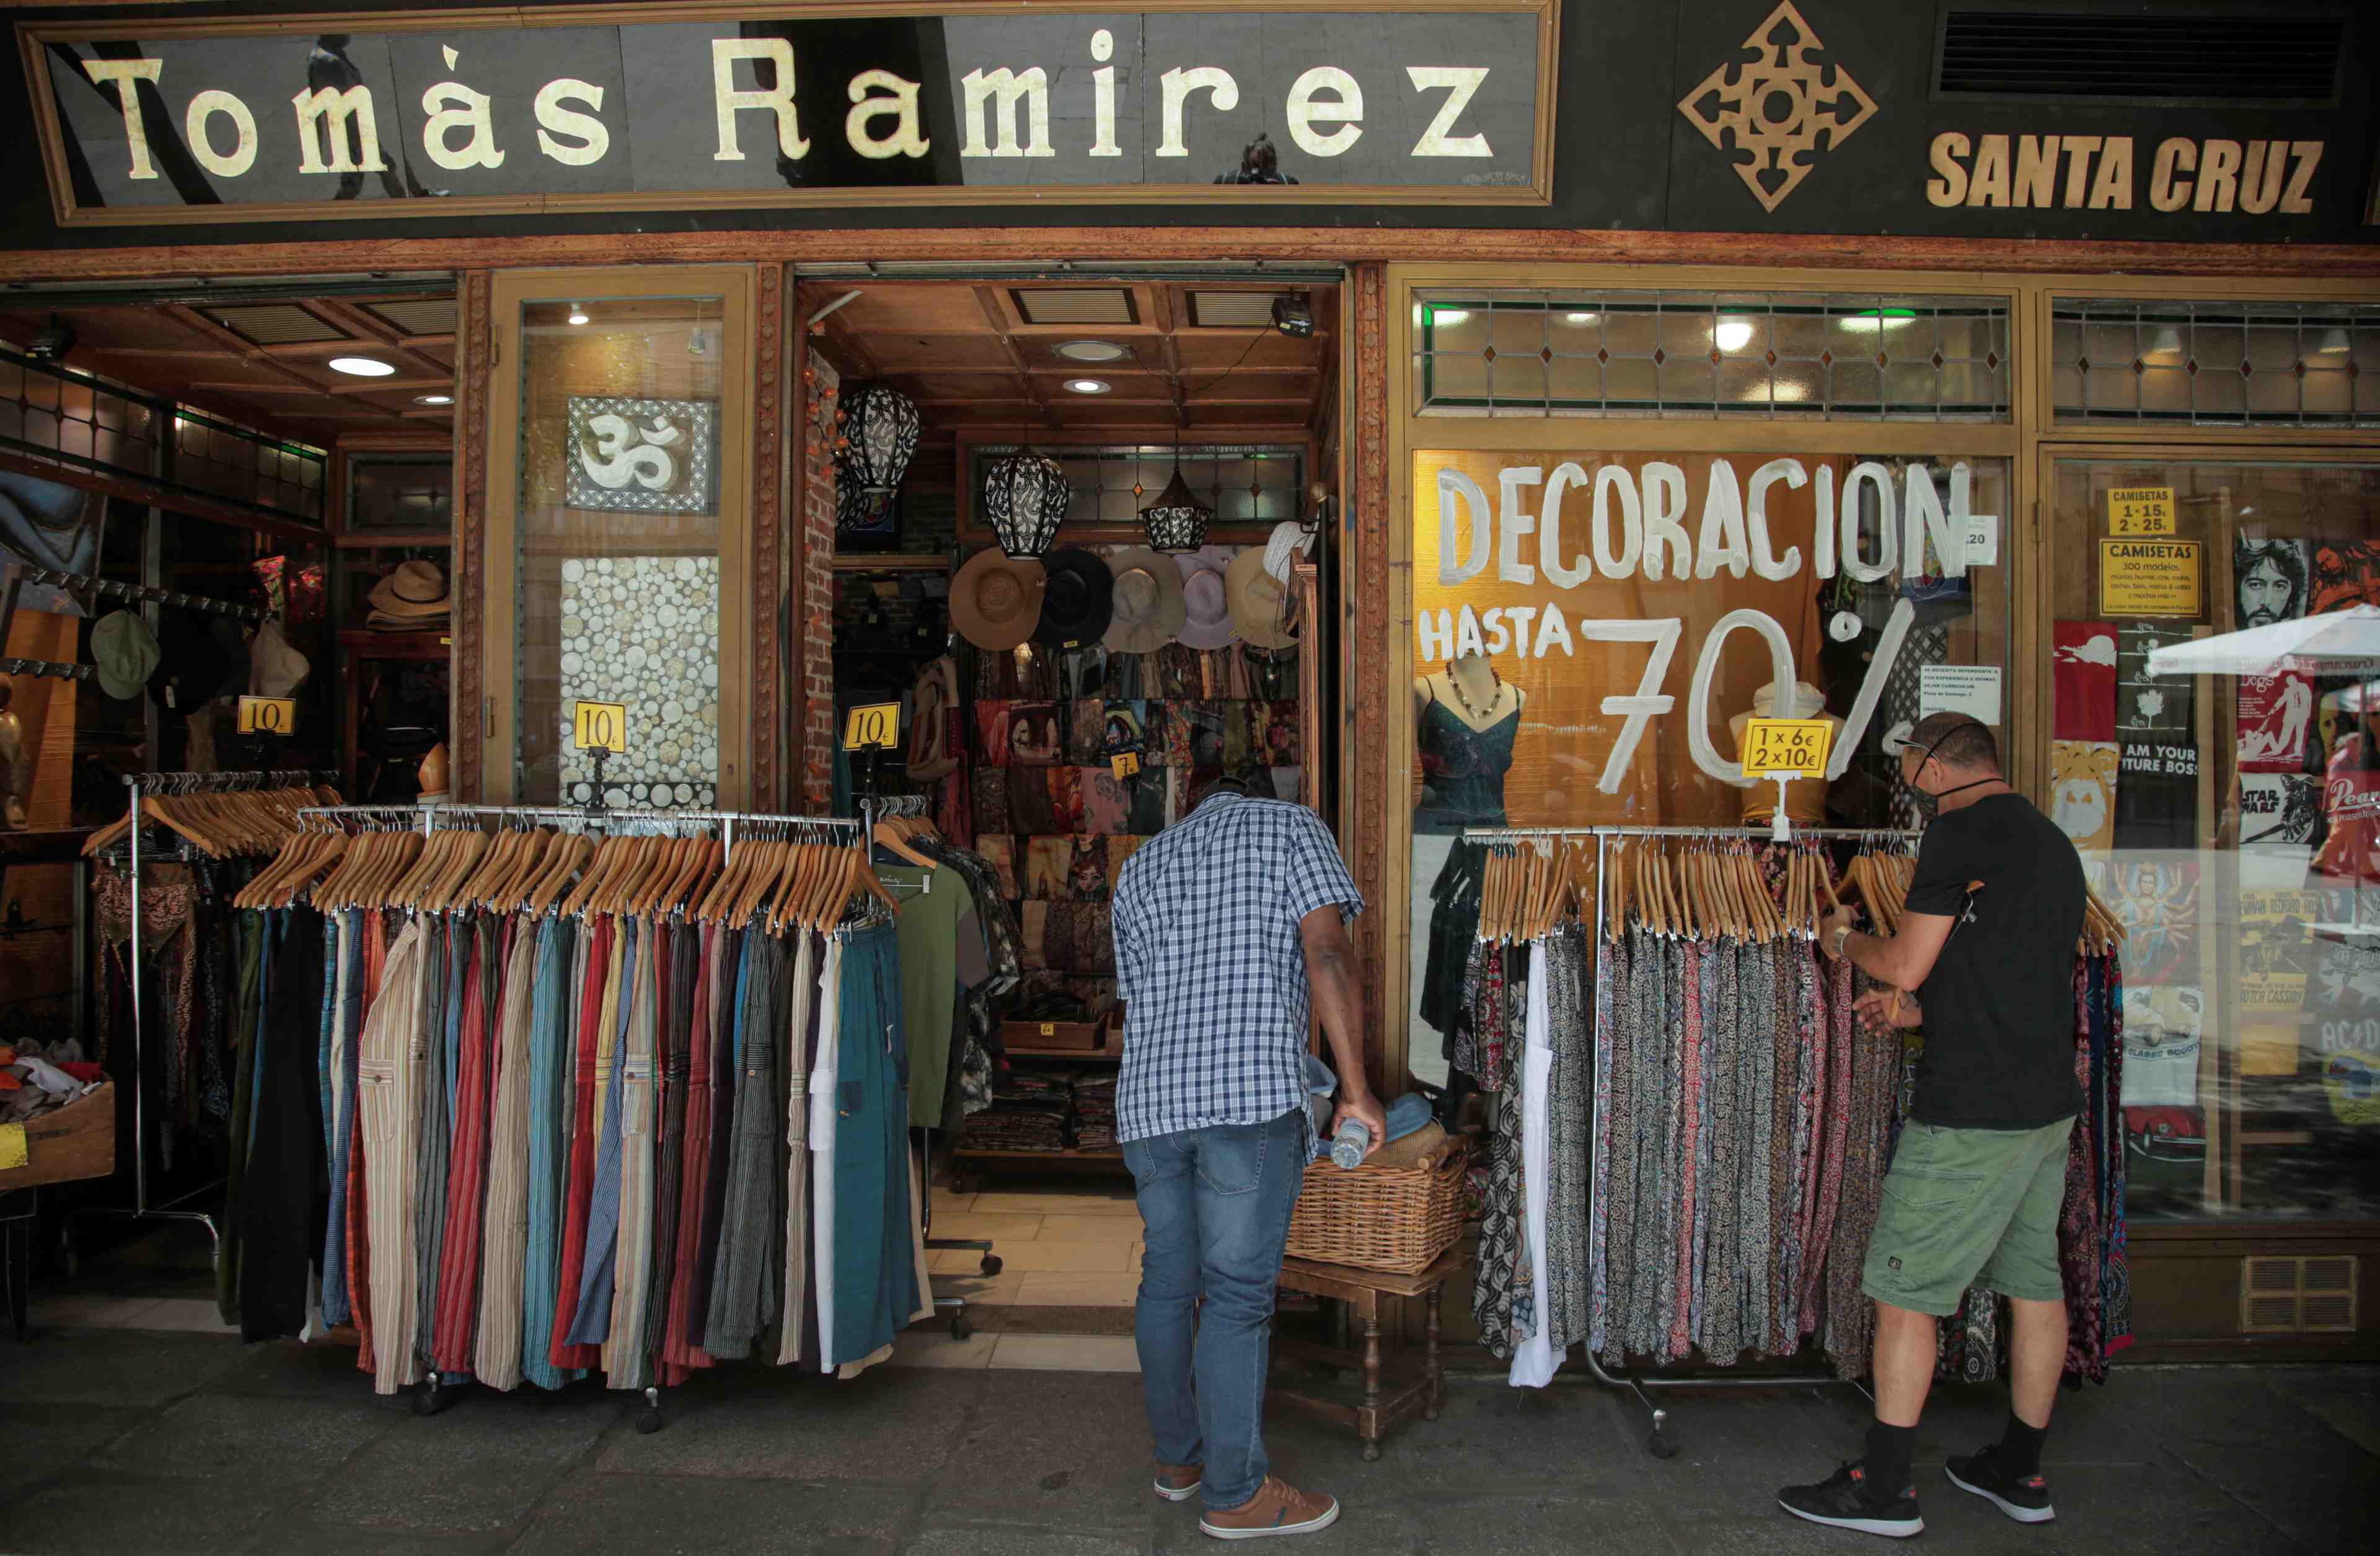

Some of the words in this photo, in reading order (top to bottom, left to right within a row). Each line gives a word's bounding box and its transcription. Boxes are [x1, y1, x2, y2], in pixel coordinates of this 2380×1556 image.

[711, 29, 1494, 161] Ramirez
[1926, 131, 2133, 210] SANTA
[2149, 137, 2324, 214] CRUZ
[2113, 490, 2168, 501] CAMISETAS
[2123, 505, 2133, 517] 1
[1437, 458, 1970, 589] DECORACION
[2120, 519, 2128, 531] 2
[2110, 545, 2192, 559] CAMISETAS
[2122, 562, 2141, 570] 300
[2241, 674, 2275, 693] Dogs
[1418, 603, 1574, 662] HASTA
[1580, 598, 1915, 794] 70%
[1760, 728, 1768, 746] 1
[1774, 733, 1786, 743] x
[1791, 728, 1815, 746] 6€
[1754, 748, 1768, 767] 2
[1771, 753, 1783, 763] x
[1784, 748, 1816, 766] 10€
[2126, 744, 2151, 757] AM
[2155, 745, 2196, 761] YOUR
[2122, 757, 2161, 772] TURE
[2242, 789, 2280, 802] STAR
[2241, 801, 2280, 814] WARS
[2270, 898, 2301, 913] REDFORD
[2267, 988, 2305, 1003] CASSIDY
